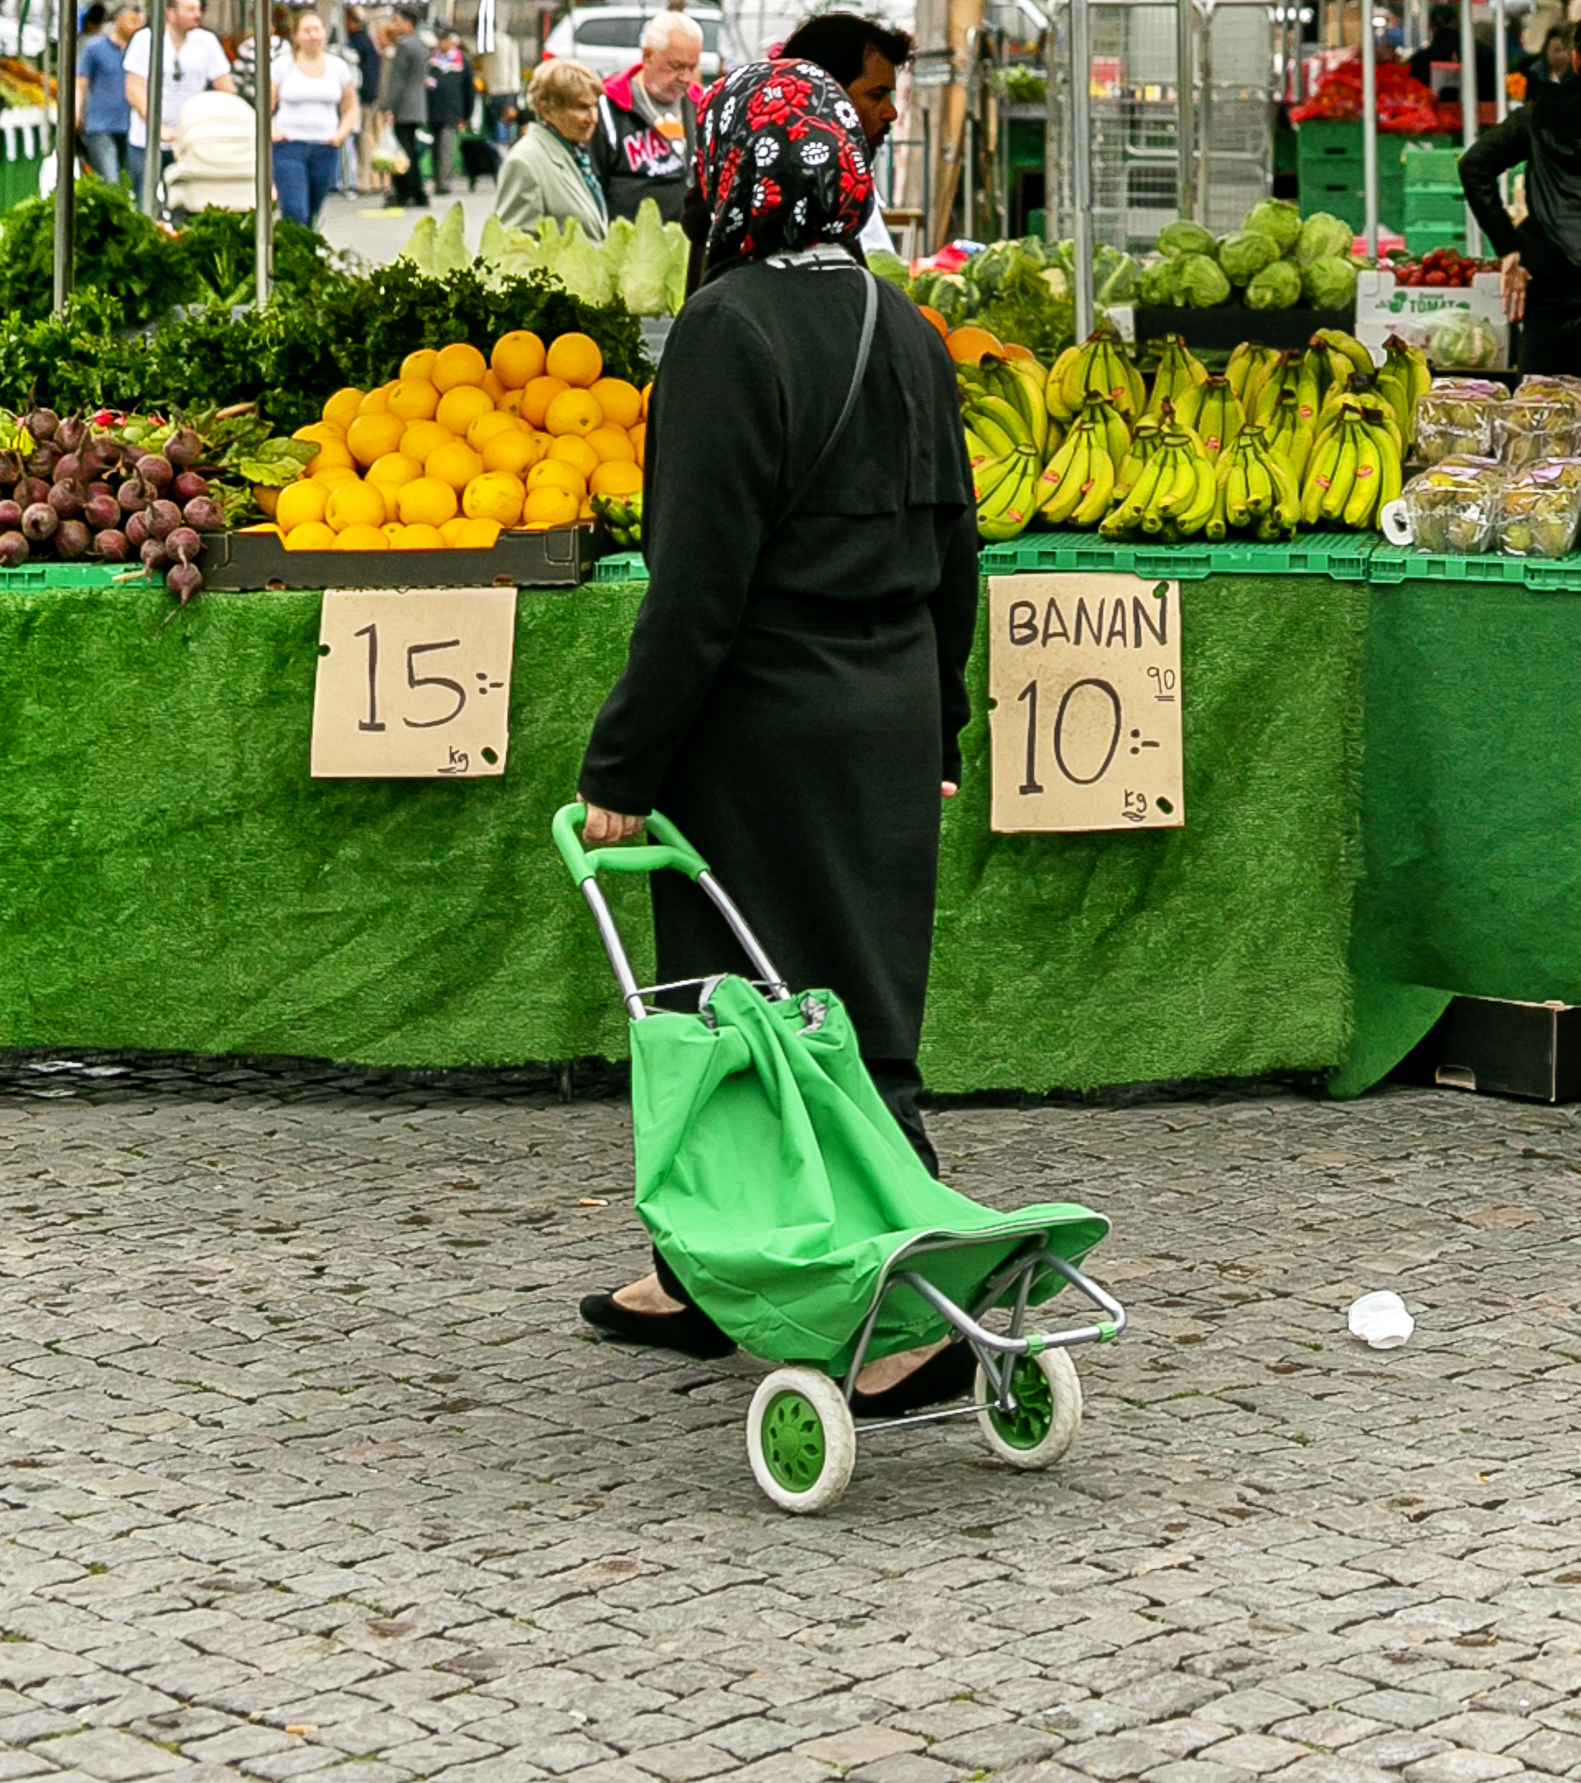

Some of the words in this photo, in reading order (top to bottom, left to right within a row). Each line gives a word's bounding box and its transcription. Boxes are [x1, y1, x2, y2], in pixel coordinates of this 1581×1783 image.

[1008, 596, 1168, 649] BANAN
[353, 622, 505, 732] 15:-
[1146, 665, 1176, 702] 90
[448, 744, 470, 773] kg
[1016, 677, 1161, 796] 10:-
[1122, 788, 1148, 822] kg
